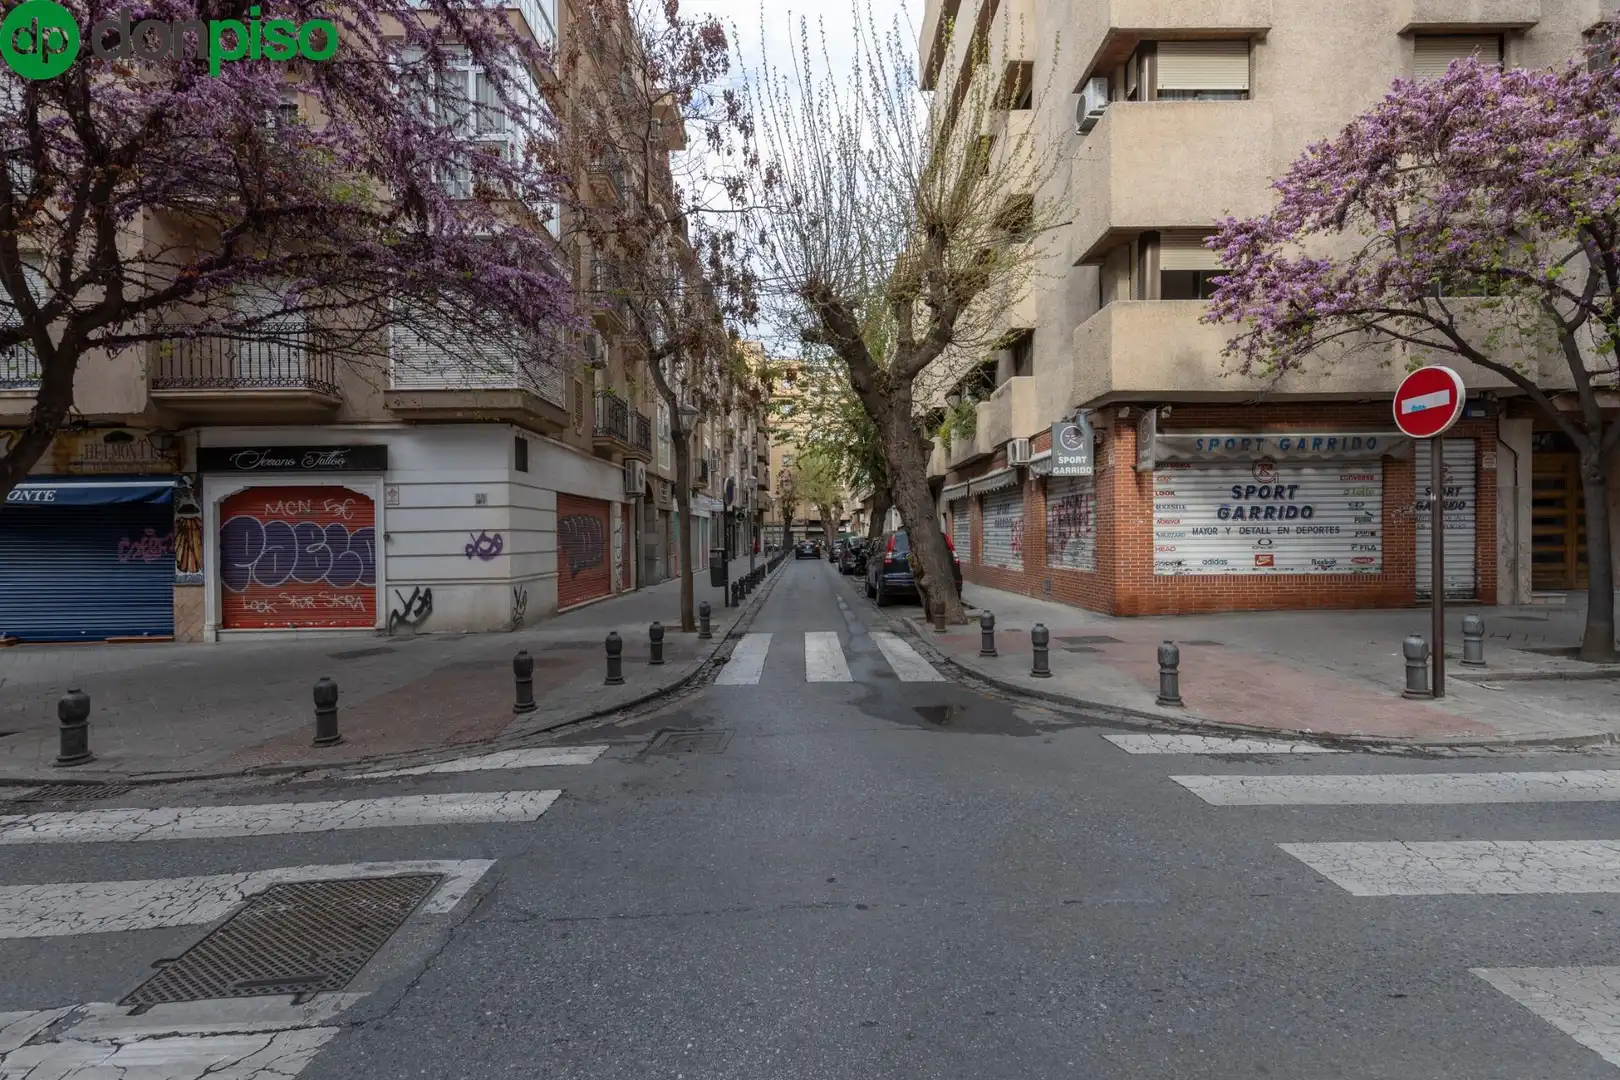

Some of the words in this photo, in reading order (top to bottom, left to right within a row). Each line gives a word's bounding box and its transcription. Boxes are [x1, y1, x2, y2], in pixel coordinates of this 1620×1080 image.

[1195, 437, 1266, 452] SPORT
[1277, 436, 1378, 452] GARRIDO
[301, 448, 351, 468] Tattoo
[1058, 456, 1087, 464] SPORT
[1053, 466, 1092, 474] GARRIDO
[1231, 484, 1300, 500] SPORT
[1217, 505, 1314, 521] GARRIDO
[1192, 526, 1218, 535] MAYOR
[1225, 526, 1232, 535] Y
[1239, 526, 1271, 535] DETALL
[1277, 526, 1290, 534] EN
[1296, 525, 1340, 535] DEPORTES
